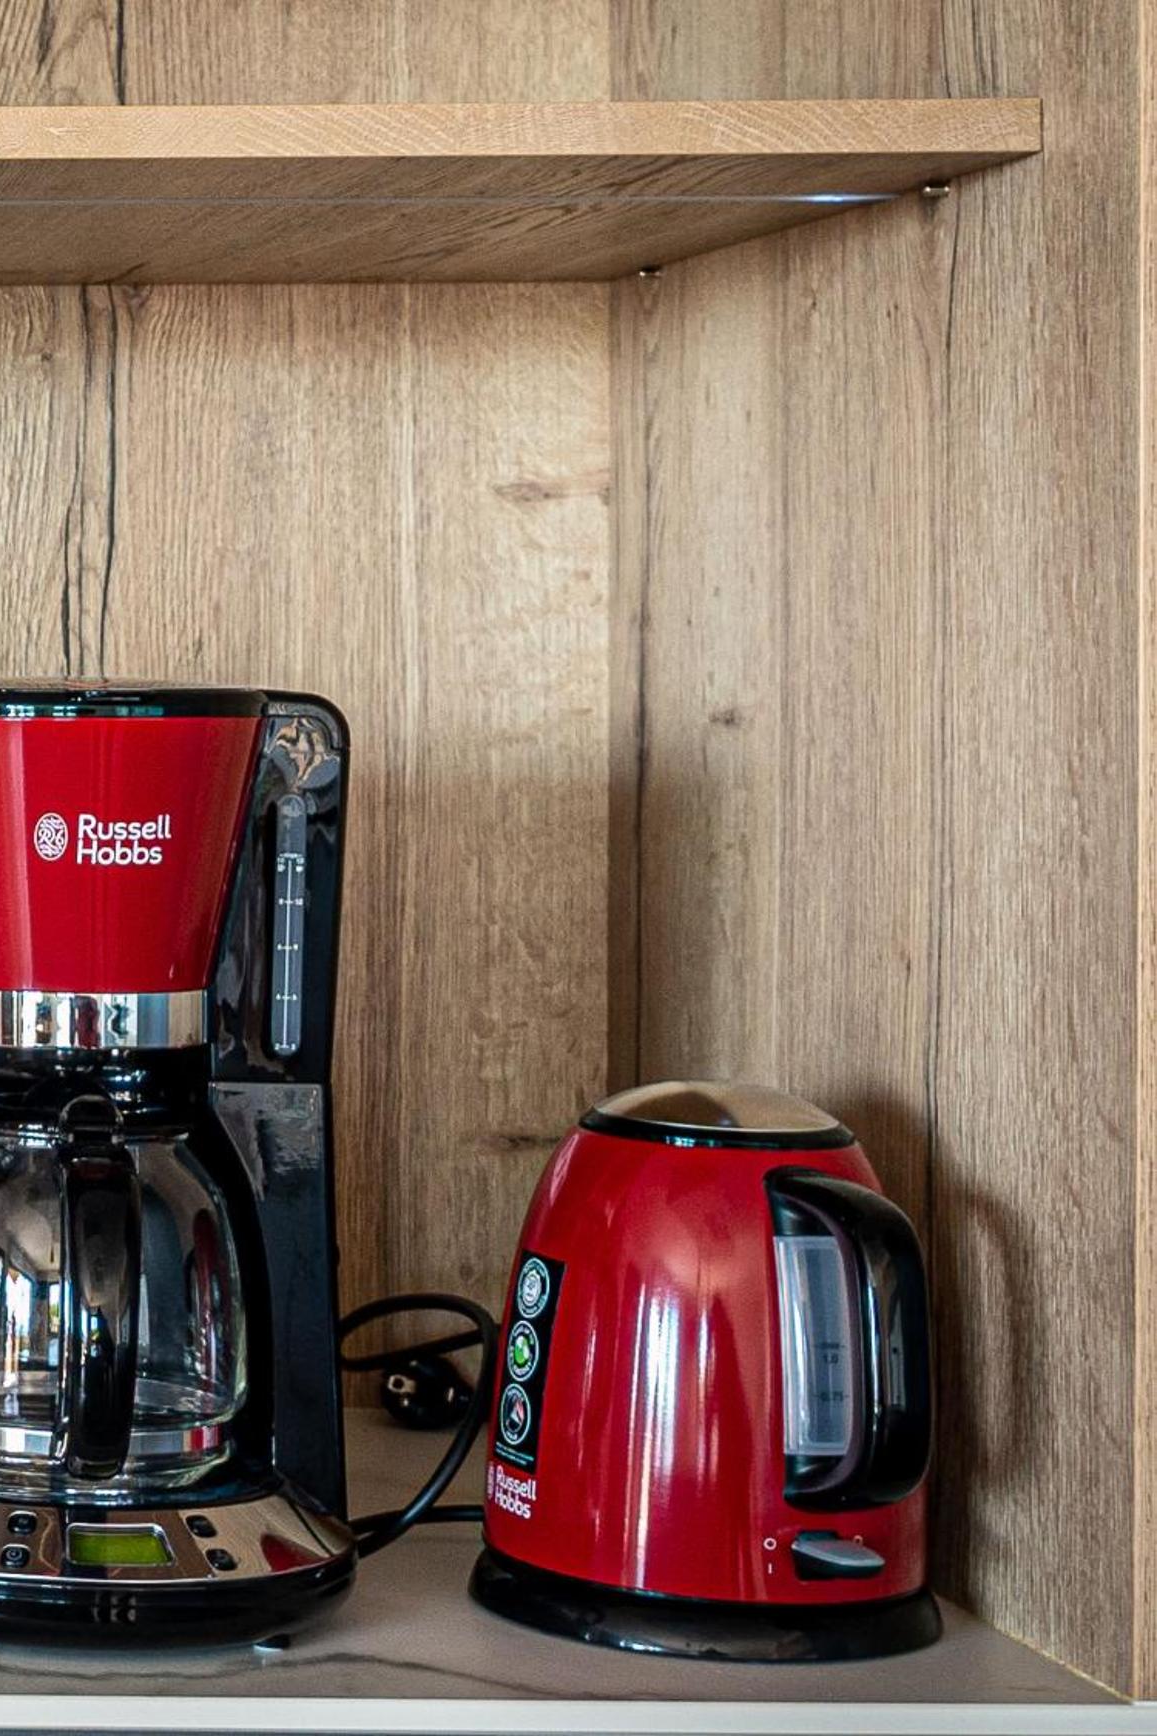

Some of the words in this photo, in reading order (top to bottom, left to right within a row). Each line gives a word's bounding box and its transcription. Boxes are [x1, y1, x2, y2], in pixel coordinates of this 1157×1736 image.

[78, 813, 172, 840] Russell
[76, 838, 163, 865] Hobbs
[496, 1464, 537, 1502] Russell
[494, 1485, 532, 1519] Hobbs
